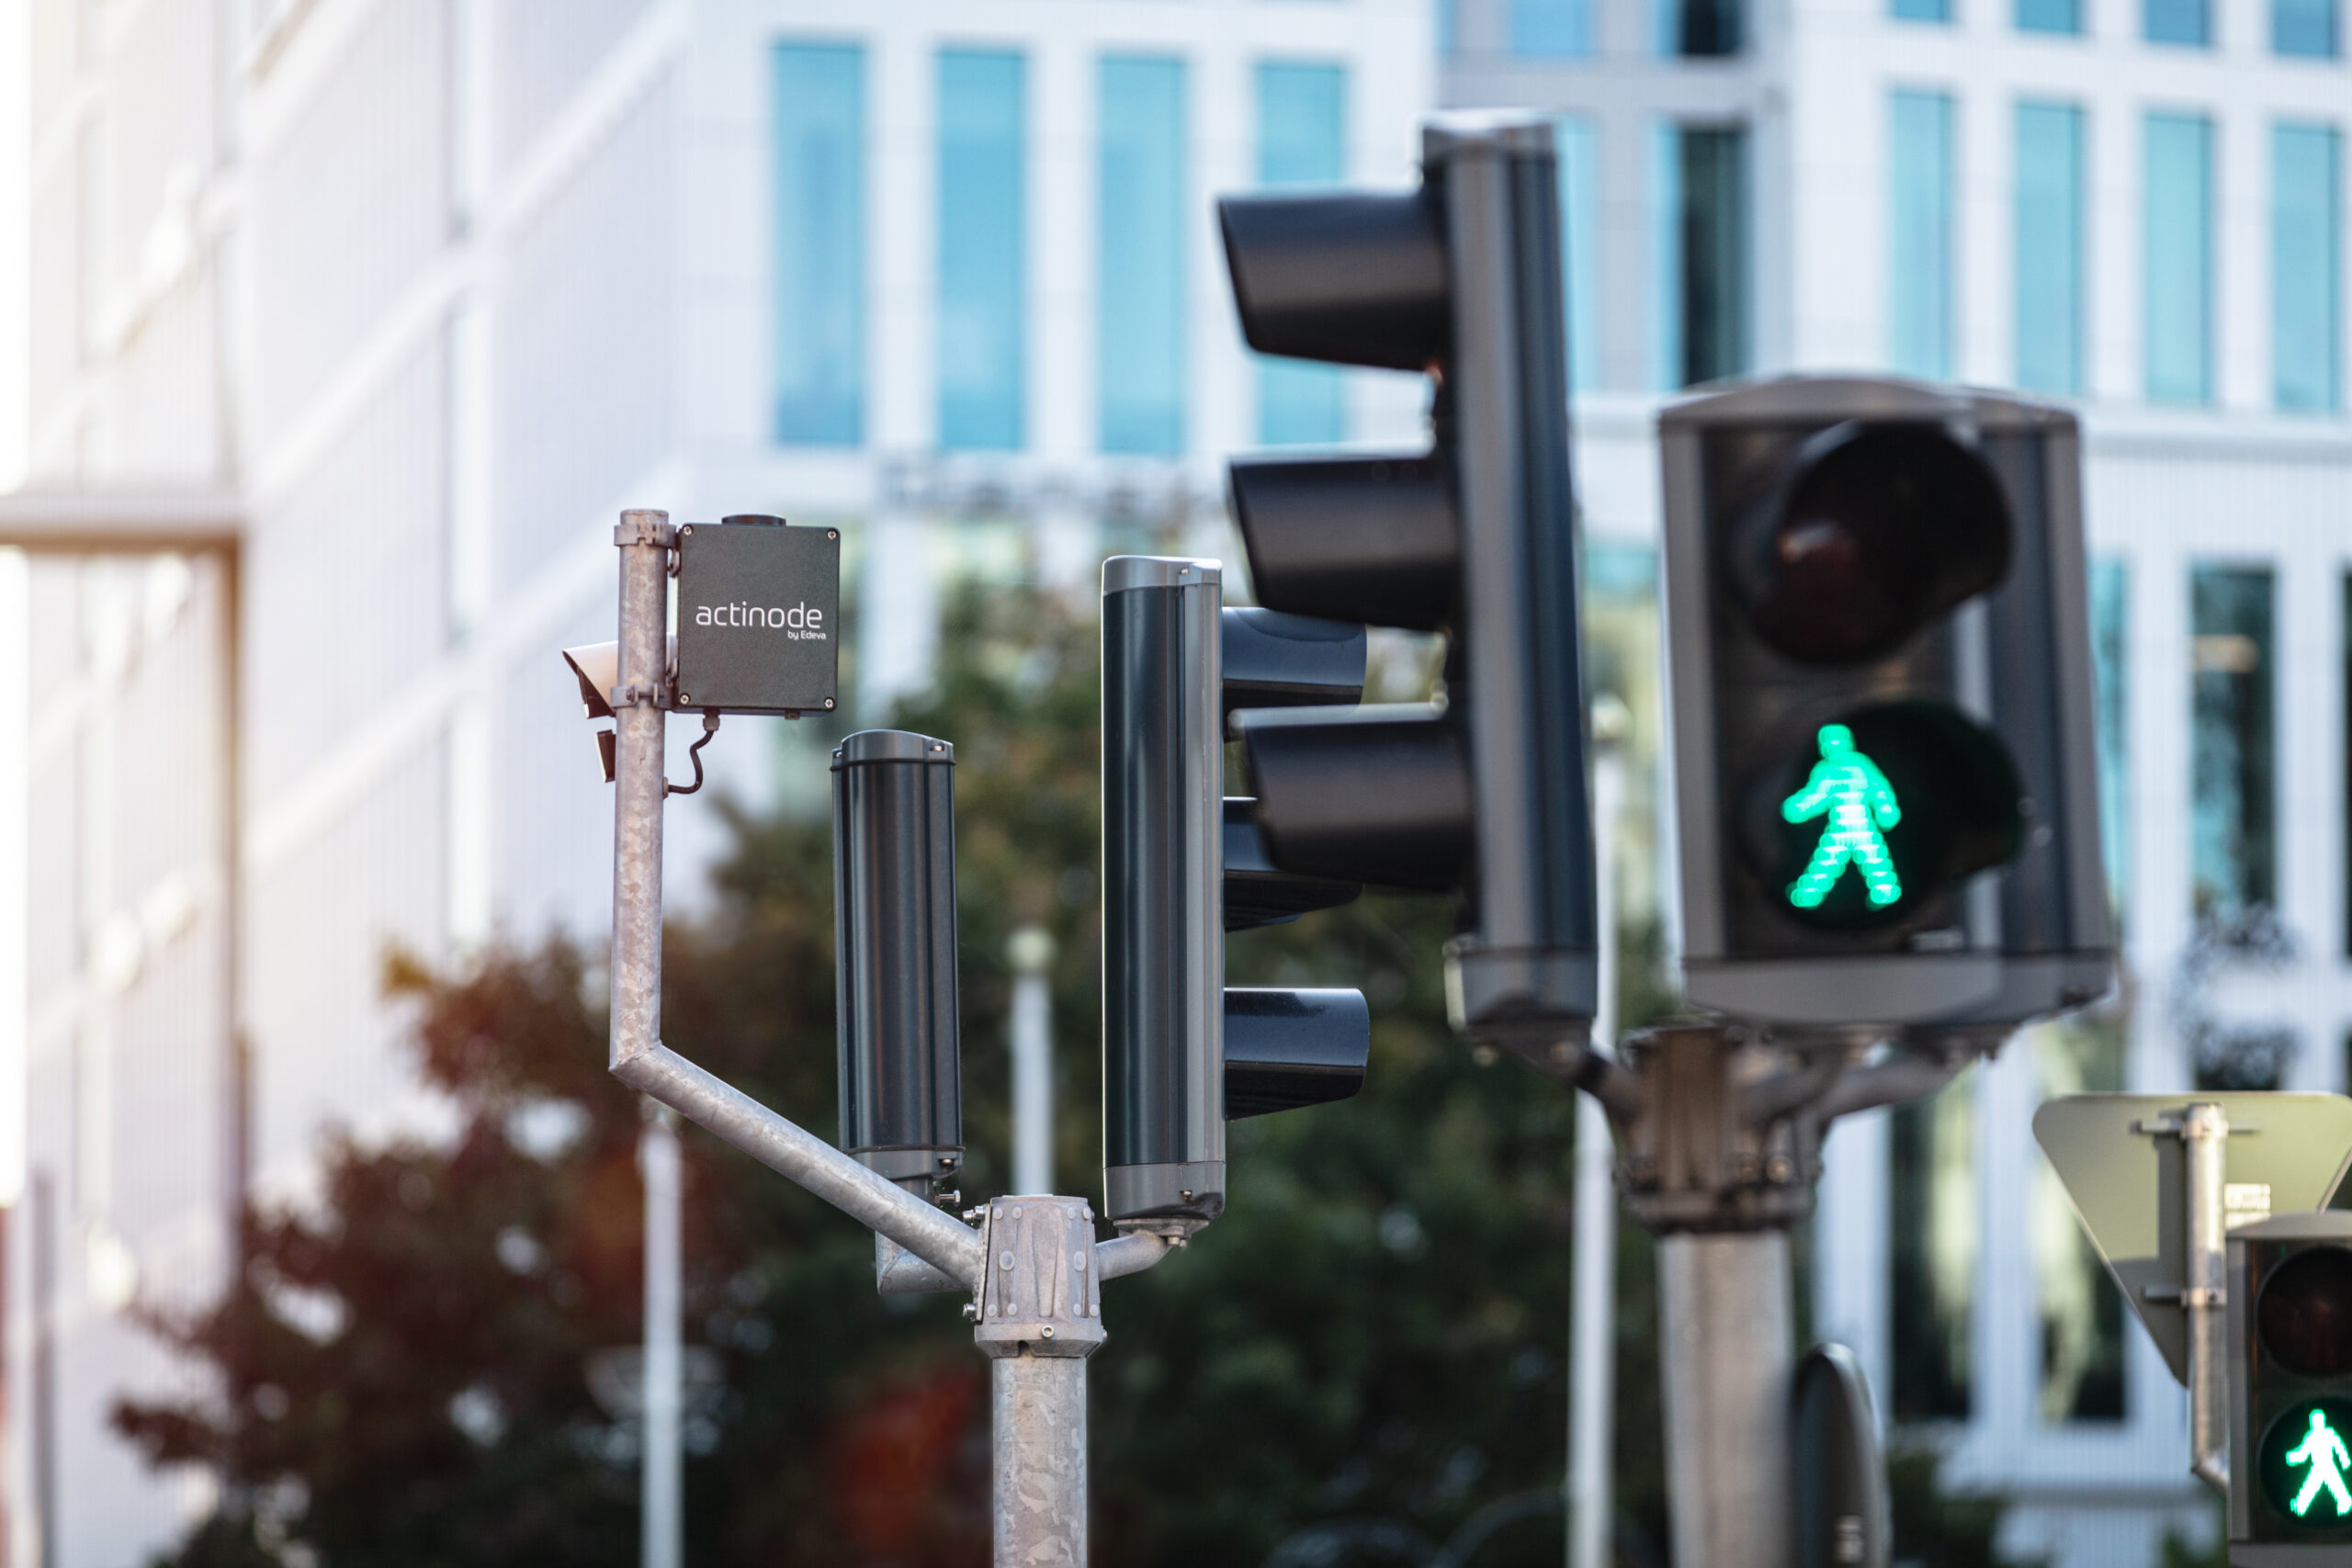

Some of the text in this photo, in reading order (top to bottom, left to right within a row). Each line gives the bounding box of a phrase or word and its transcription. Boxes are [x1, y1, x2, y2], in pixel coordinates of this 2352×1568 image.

[695, 601, 822, 628] actinode
[787, 630, 826, 640] by Edeva
